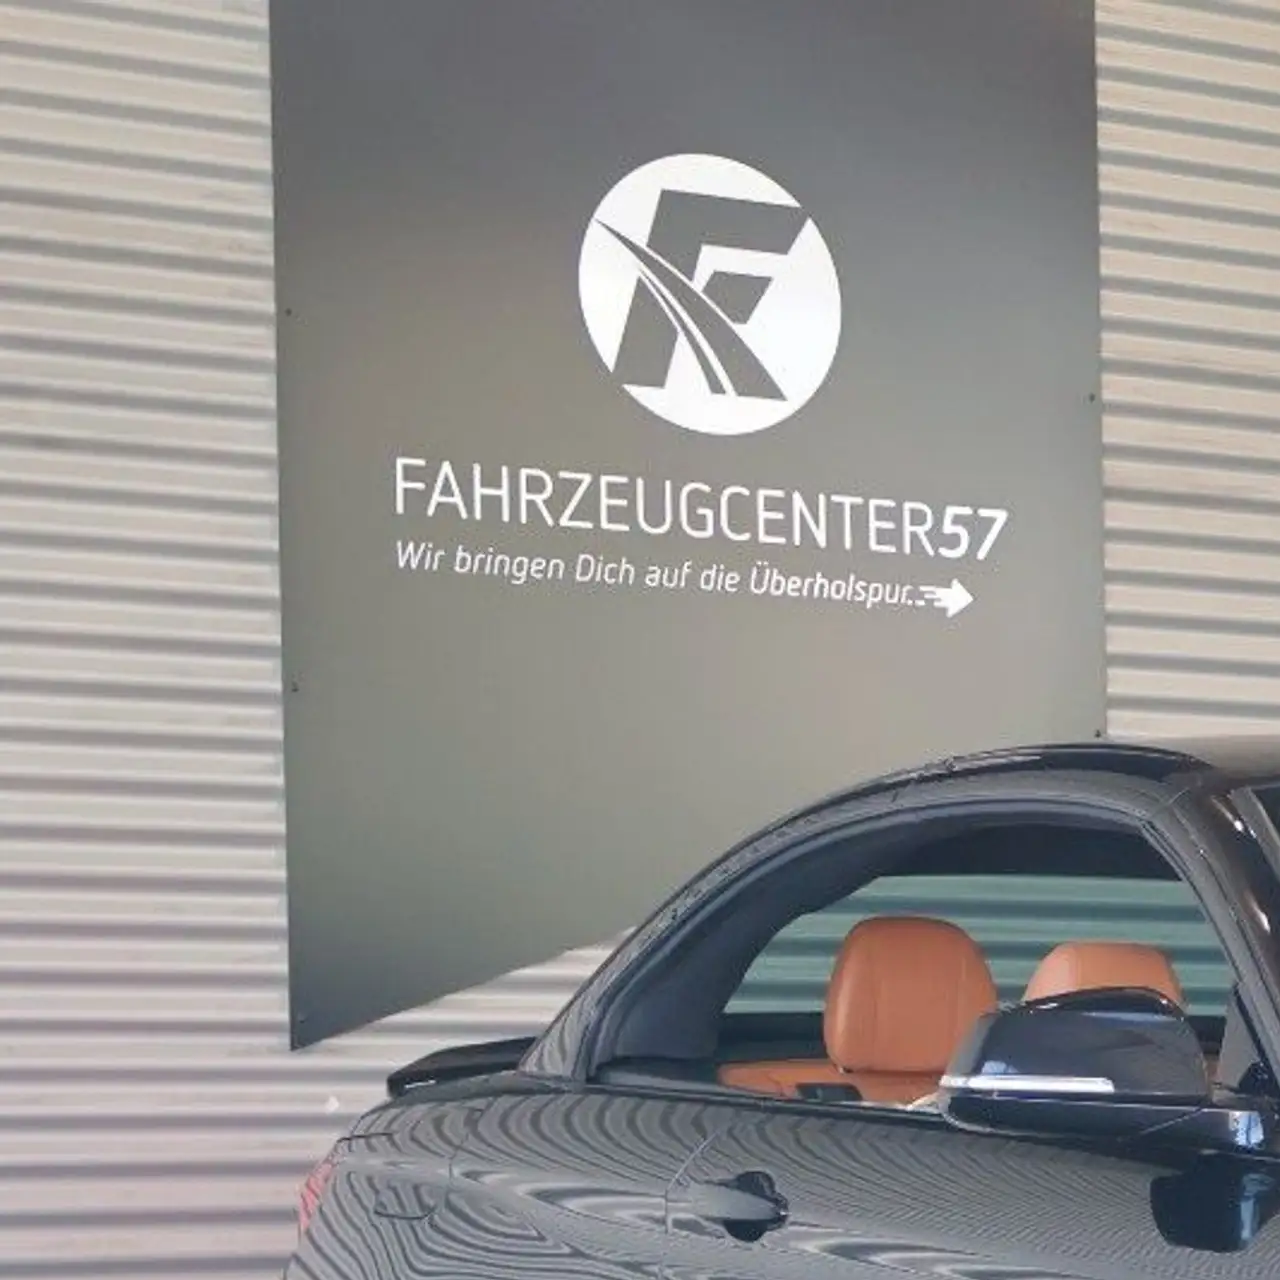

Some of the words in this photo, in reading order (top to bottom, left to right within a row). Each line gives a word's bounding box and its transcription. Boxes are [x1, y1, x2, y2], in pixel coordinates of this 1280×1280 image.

[394, 457, 1008, 560] FAHRZEUGCENTER57
[397, 540, 445, 572] Wir
[454, 544, 565, 585] bringen
[575, 552, 636, 585] Dich
[644, 560, 693, 589] auf
[699, 564, 741, 593] die
